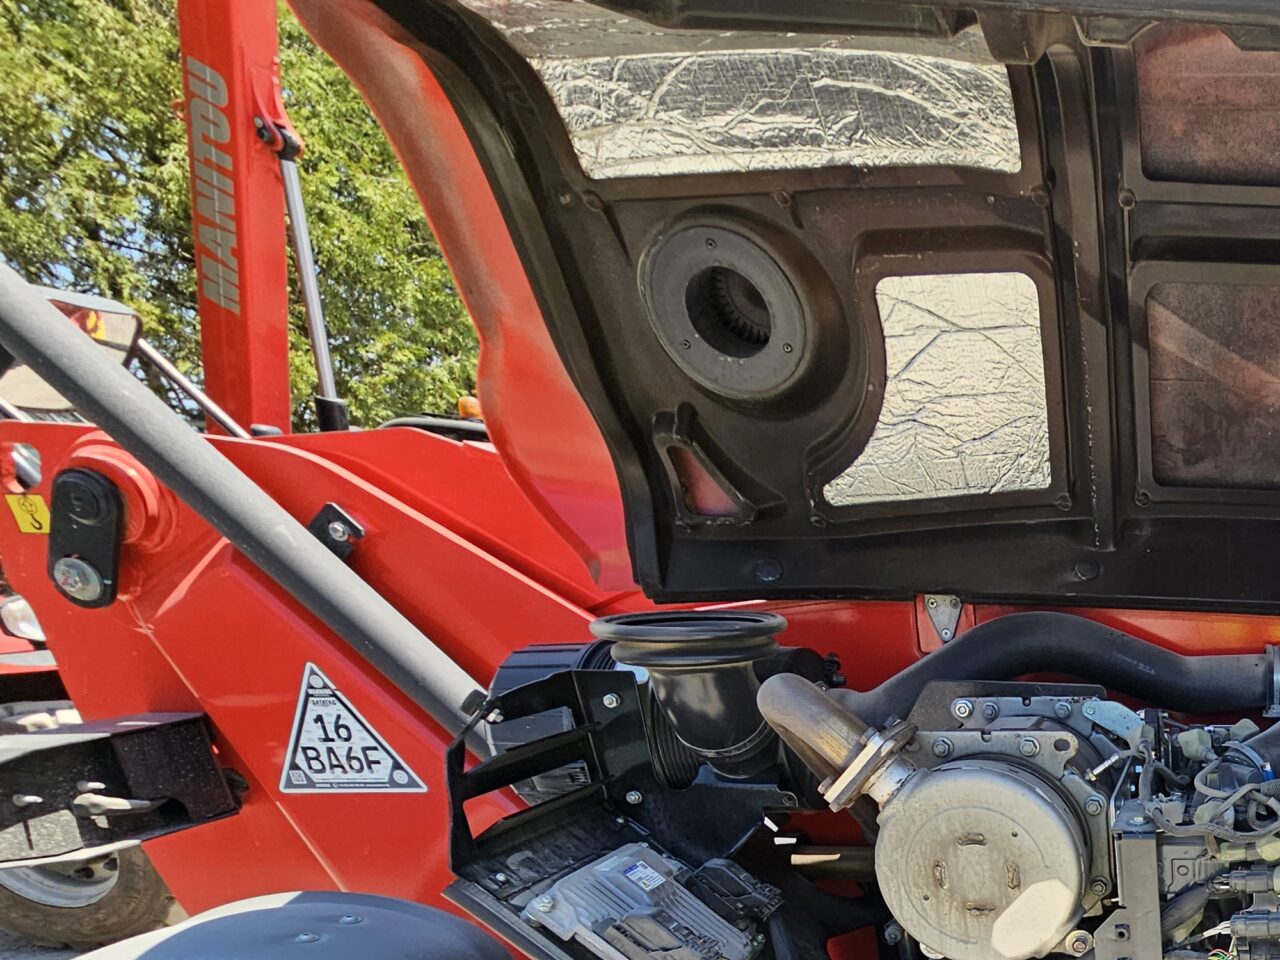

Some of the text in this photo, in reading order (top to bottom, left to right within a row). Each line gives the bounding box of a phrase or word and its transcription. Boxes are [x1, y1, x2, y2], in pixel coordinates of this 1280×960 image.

[187, 56, 240, 315] MANITOU
[313, 714, 352, 742] 16
[300, 746, 381, 774] BA6F
